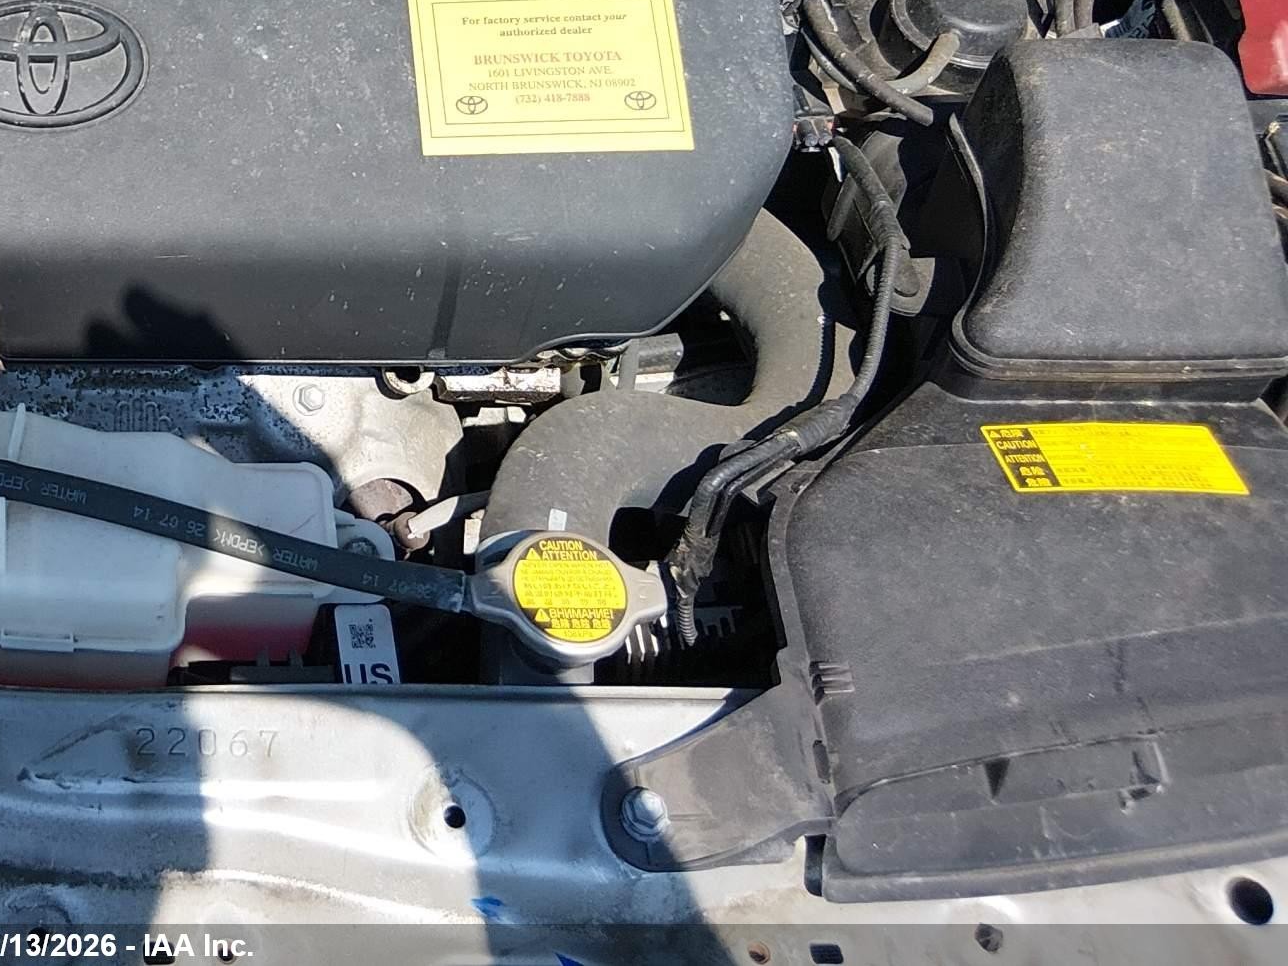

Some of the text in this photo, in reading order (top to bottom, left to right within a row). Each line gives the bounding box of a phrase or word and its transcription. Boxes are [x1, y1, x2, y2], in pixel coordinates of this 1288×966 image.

[462, 13, 627, 26] For factory service contact your
[499, 26, 593, 37] authorized dealer
[474, 50, 622, 65] BRUNSWICK TOYOTA
[513, 66, 585, 77] LIVINGSTON
[469, 82, 509, 91] NORTH
[589, 79, 602, 88] NJ
[515, 94, 542, 104] (732)
[995, 439, 1038, 450] CAUTION
[1004, 453, 1046, 464] ATTENTION
[41, 488, 88, 505] WATER
[133, 505, 151, 522] 14
[186, 519, 207, 538] 26
[538, 540, 584, 551] CAUTION
[272, 546, 319, 571] WATER
[541, 550, 598, 561] ATTENTION
[136, 726, 279, 758] 22067
